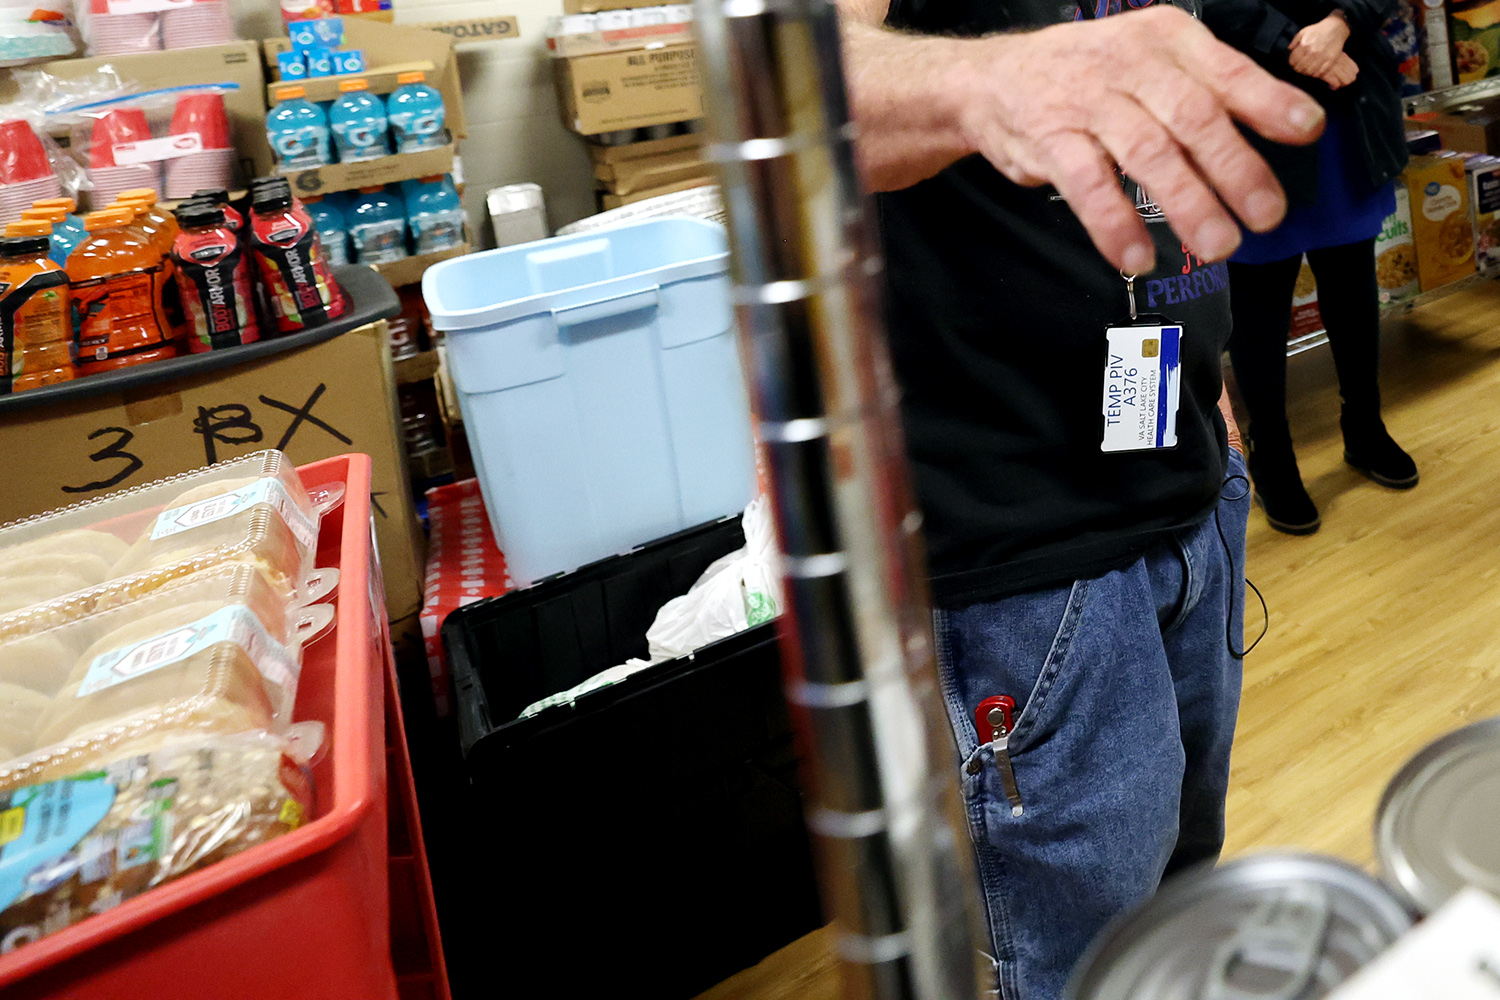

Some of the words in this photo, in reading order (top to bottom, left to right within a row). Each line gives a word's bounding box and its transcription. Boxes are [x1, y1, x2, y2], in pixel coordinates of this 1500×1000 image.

[1378, 221, 1408, 242] cuits
[289, 247, 315, 309] BODYARMOR
[1146, 264, 1227, 308] PERFOR
[210, 268, 231, 333] BODYARMOR
[1109, 354, 1123, 379] PIV
[1123, 367, 1138, 407] A376
[1140, 376, 1149, 393] CITY
[1148, 369, 1157, 397] SYSTEM
[1107, 384, 1122, 428] TEMP
[1139, 393, 1148, 411] LAKE
[1147, 398, 1156, 417] CARE
[1139, 412, 1147, 429] SALT
[1147, 418, 1155, 446] HEALTH
[1138, 430, 1146, 441] VA
[60, 425, 145, 494] 3
